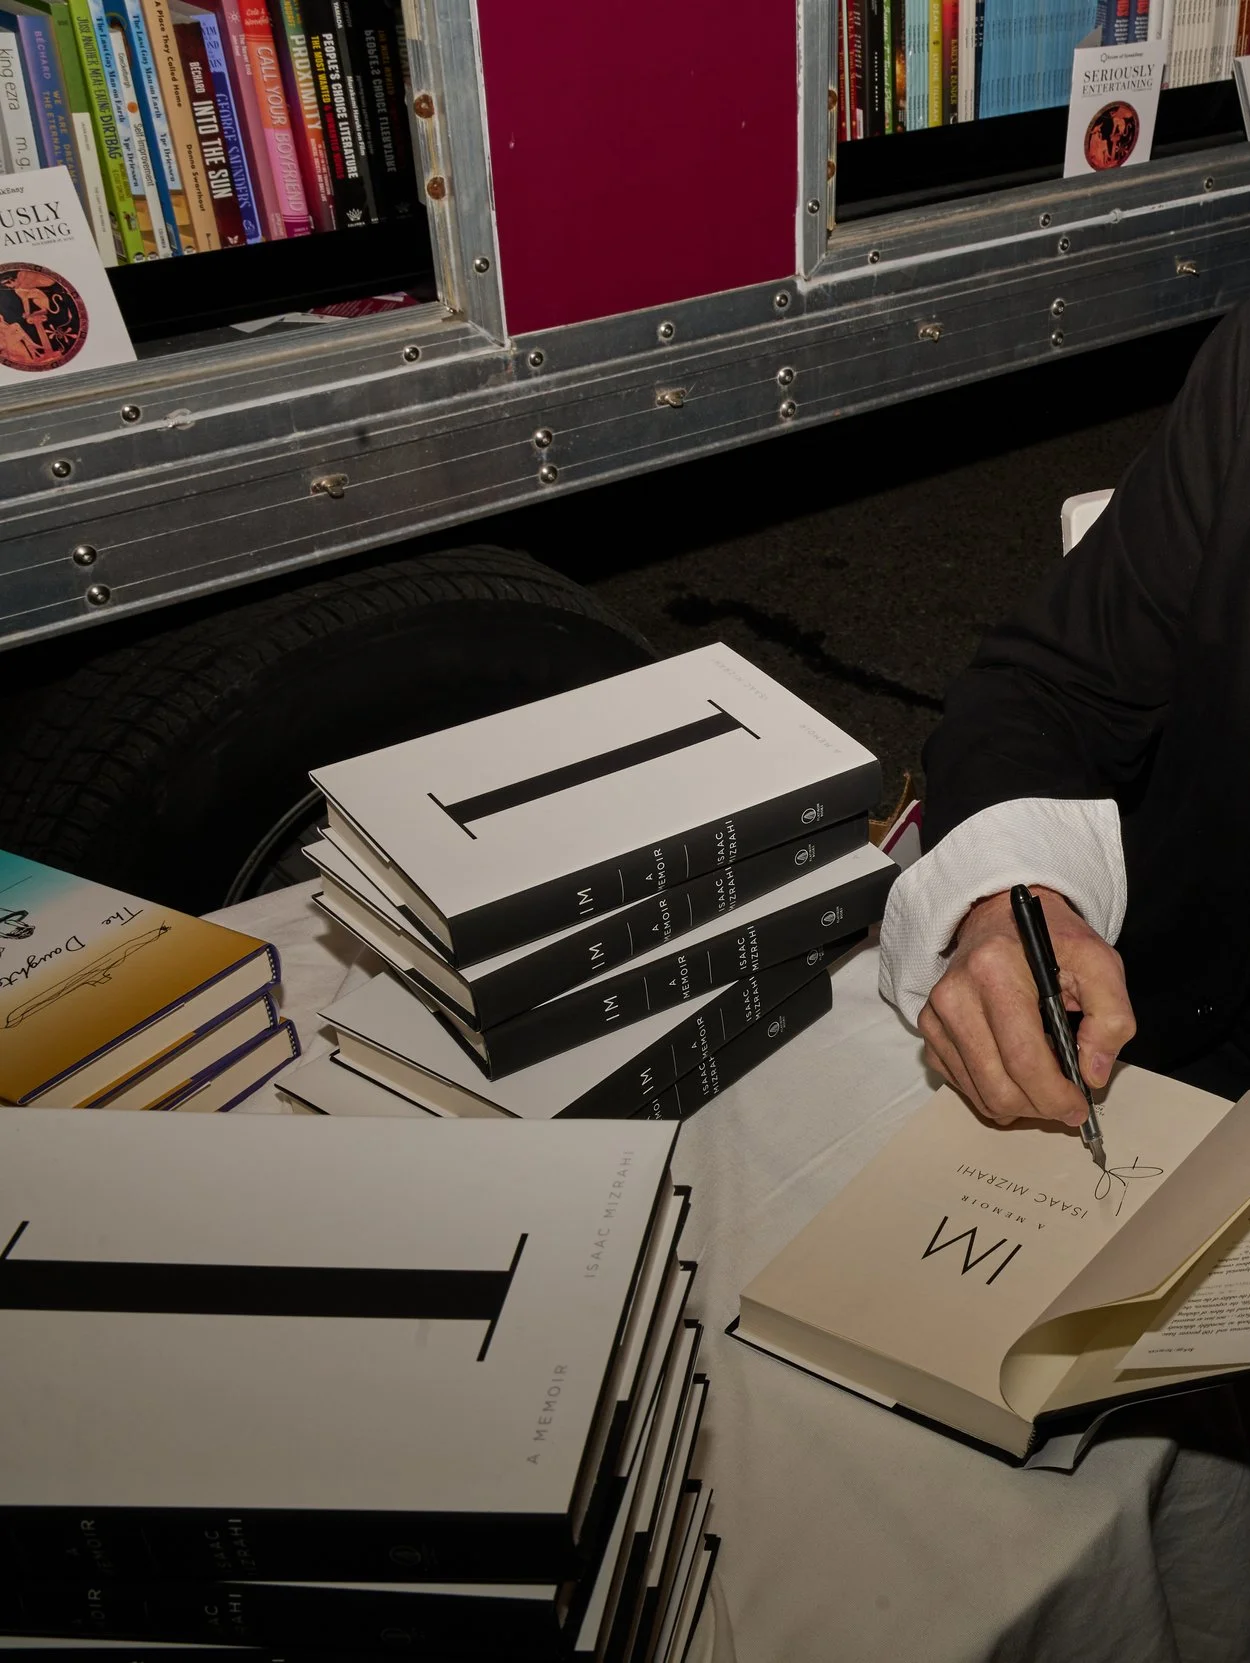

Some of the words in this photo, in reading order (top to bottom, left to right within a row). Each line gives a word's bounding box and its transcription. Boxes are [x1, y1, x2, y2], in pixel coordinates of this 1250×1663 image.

[96, 18, 104, 32] The
[132, 15, 142, 30] The
[333, 2, 343, 29] YAMADA
[932, 4, 940, 32] DEATH
[33, 31, 52, 80] BÉCHARD
[100, 33, 109, 54] Last
[136, 30, 145, 51] Last
[311, 36, 320, 50] THE
[322, 32, 340, 80] PEOPLE'S
[0, 48, 14, 78] king
[104, 53, 112, 69] Gay
[141, 50, 149, 66] Gay
[156, 10, 166, 32] Place
[162, 33, 170, 54] They
[167, 56, 178, 82] Called
[174, 84, 182, 108] Home
[257, 46, 282, 83] CALL
[314, 51, 325, 72] MOST
[1084, 64, 1155, 84] SERIOUSLY
[109, 70, 118, 88] Man
[149, 85, 156, 96] on
[189, 61, 206, 94] BÉCHARD
[290, 34, 322, 130] PROXIMITY
[318, 73, 330, 104] WANTED
[1082, 79, 1153, 95] ENTERTAINING
[5, 82, 20, 110] ezra
[82, 36, 98, 66] ANOTHER
[100, 114, 122, 160] DIRTBAG
[113, 88, 119, 100] on
[151, 96, 161, 119] Earth
[266, 86, 289, 126] YOUR
[332, 83, 348, 120] CHOICE
[932, 86, 940, 122] TILLMAN
[42, 92, 52, 109] THE
[48, 112, 58, 156] ETERNAL
[53, 91, 62, 104] WE
[58, 115, 68, 134] ARE
[115, 100, 126, 123] Earth
[192, 100, 220, 136] INTO
[346, 76, 358, 110] Murakami
[352, 110, 362, 131] Haruki
[358, 142, 366, 156] Film
[16, 137, 28, 154] m.
[133, 124, 155, 186] Self-Improvement
[202, 138, 226, 166] THE
[215, 93, 238, 142] GEORGE
[228, 146, 252, 209] SAUNDERS
[338, 121, 359, 180] LITERATURE
[126, 152, 140, 187] Driessen
[164, 146, 176, 182] Driessen
[186, 144, 196, 170] Donna
[192, 171, 206, 212] Swarthout
[275, 132, 304, 212] BOYFRIEND
[0, 186, 24, 196] kEasy
[208, 168, 234, 200] SUN
[0, 201, 60, 228] USLY
[4, 222, 72, 246] AINING
[716, 832, 725, 866] ISAAC
[646, 872, 653, 880] A
[724, 866, 737, 912] MIZRAHI
[577, 888, 594, 914] IM
[716, 878, 726, 912] ISAAC
[101, 906, 144, 926] The
[588, 942, 606, 970] IM
[737, 937, 748, 970] ISAAC
[747, 925, 760, 972] MIZRAHI
[668, 978, 677, 986] A
[678, 955, 691, 1000] MEMOIR
[603, 995, 620, 1021] IM
[742, 989, 752, 1022] ISAAC
[749, 975, 762, 1021] MIZRAHI
[690, 1041, 698, 1049] A
[696, 1016, 710, 1060] MEMOIR
[640, 1066, 654, 1095] IM
[698, 1062, 709, 1096] ISAAC
[709, 1056, 720, 1094] MIZRA
[956, 1164, 1030, 1196] MIZRAHI
[584, 1227, 611, 1279] ISAAC
[602, 1150, 635, 1220] MIZRAHI
[961, 1194, 1027, 1224] MEMOIR
[1033, 1192, 1088, 1220] ISAAC
[1037, 1222, 1046, 1230] A
[921, 1215, 1022, 1286] IM
[533, 1363, 568, 1442] MEMOIR
[526, 1452, 541, 1466] A
